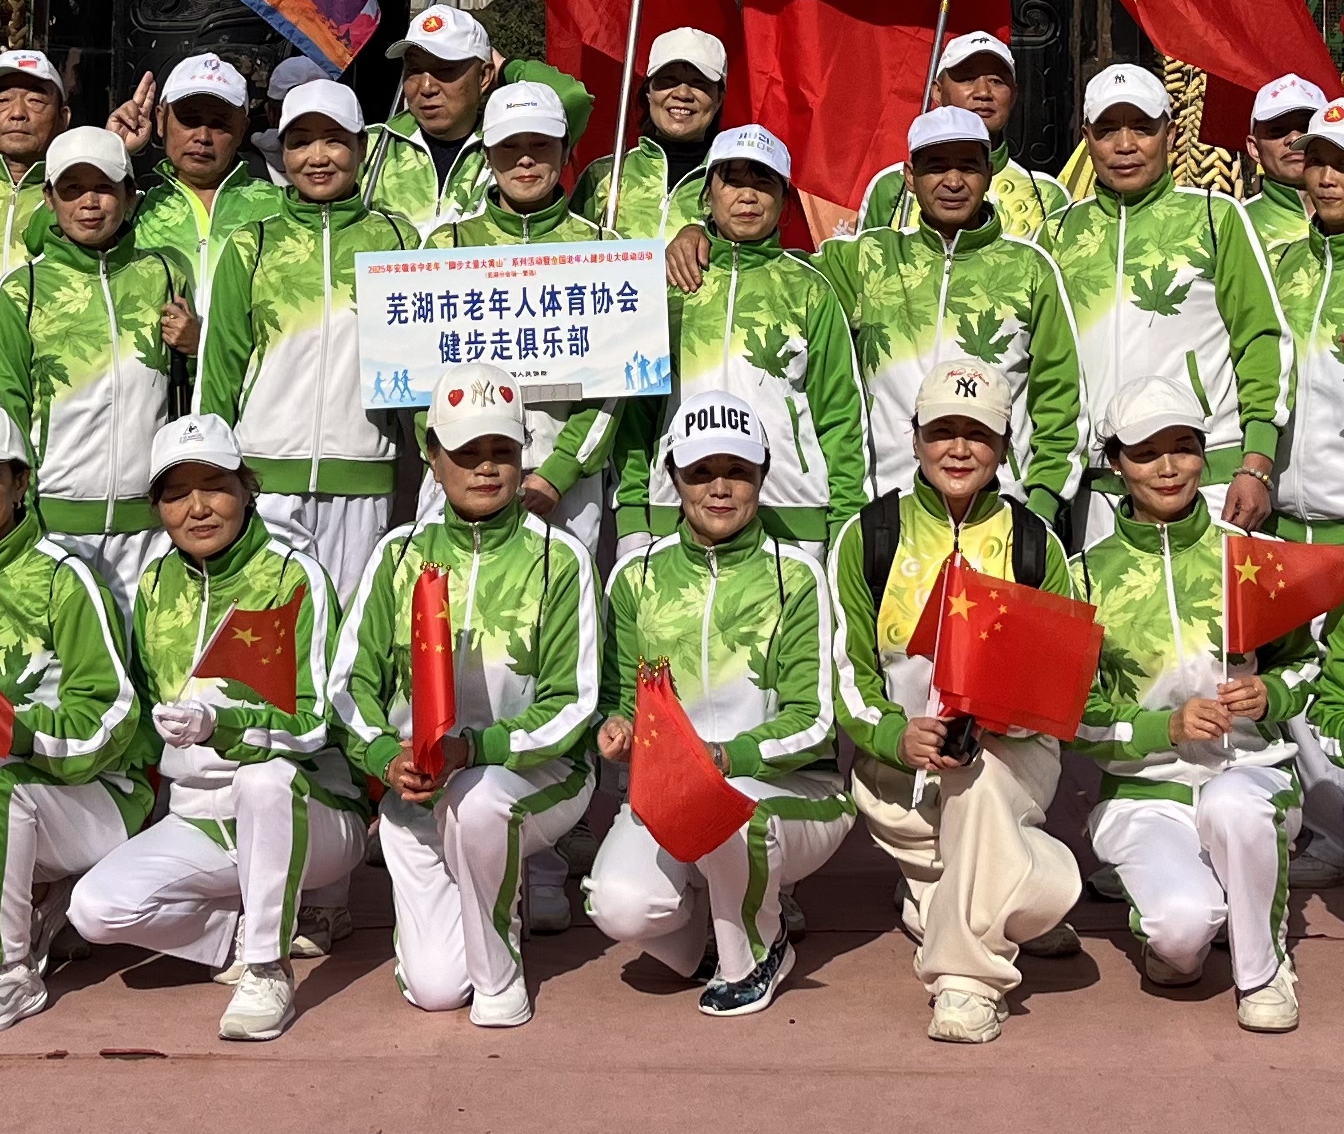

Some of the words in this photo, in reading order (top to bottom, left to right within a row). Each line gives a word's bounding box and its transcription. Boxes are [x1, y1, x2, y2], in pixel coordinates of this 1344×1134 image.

[386, 281, 639, 325] 芜湖市老年人体育协会
[438, 324, 590, 364] 健步走俱乐部
[955, 376, 977, 397] NY
[685, 405, 751, 437] POLICE
